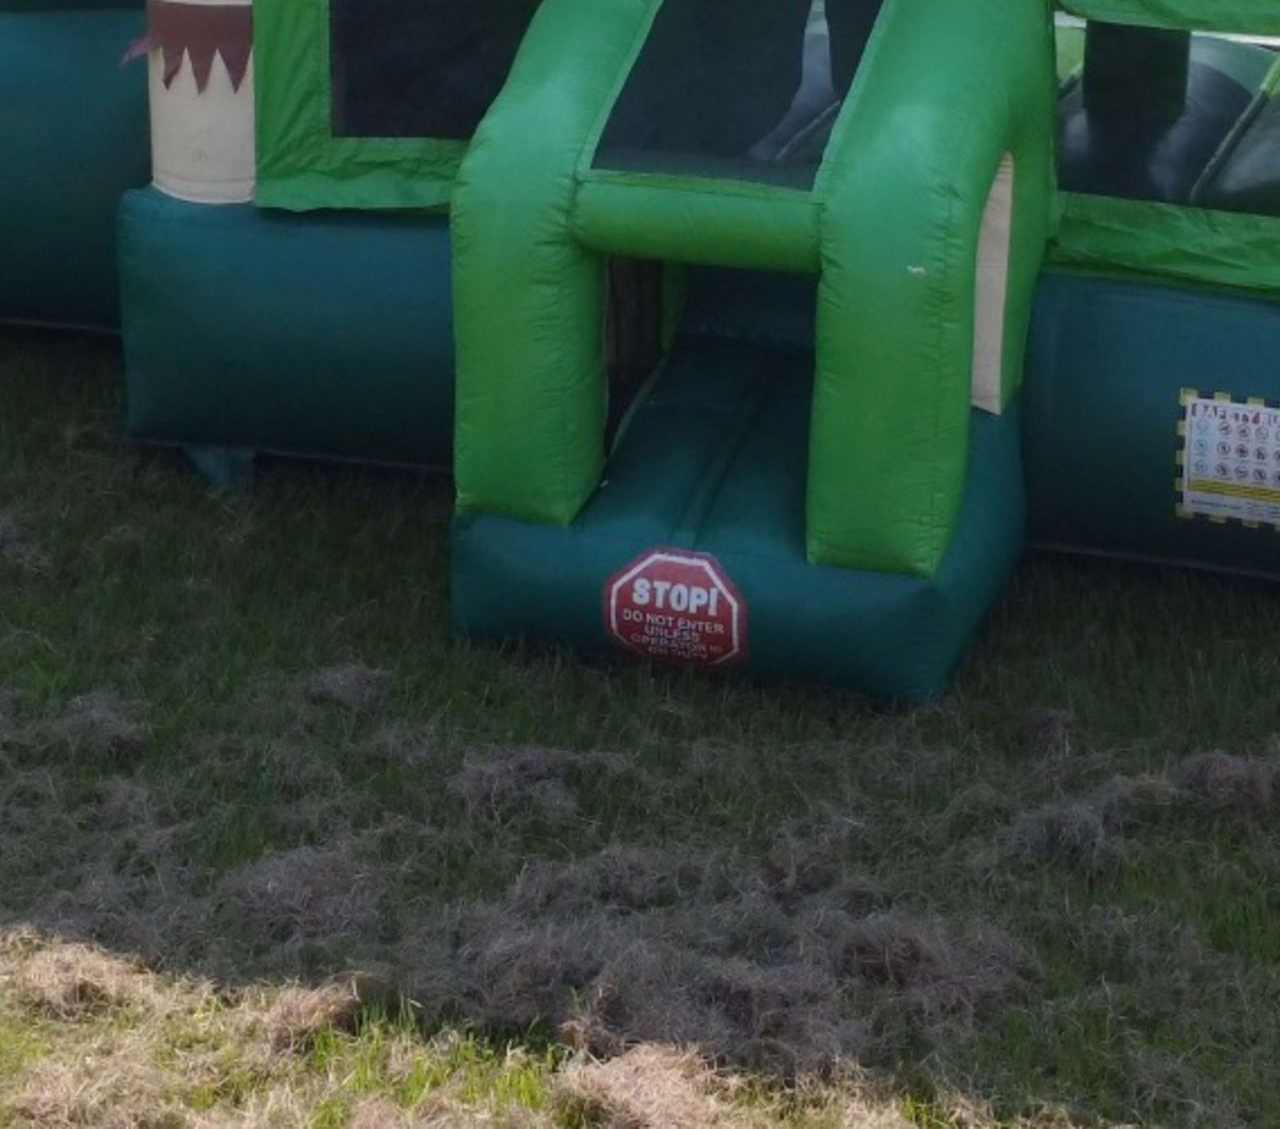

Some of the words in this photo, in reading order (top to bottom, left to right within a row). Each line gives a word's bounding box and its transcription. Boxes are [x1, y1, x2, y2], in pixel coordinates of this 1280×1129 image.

[632, 577, 719, 616] STOP!
[622, 608, 644, 622] DO
[646, 612, 675, 627] NOT
[678, 616, 725, 635] ENTER
[644, 624, 701, 643] UNLESS
